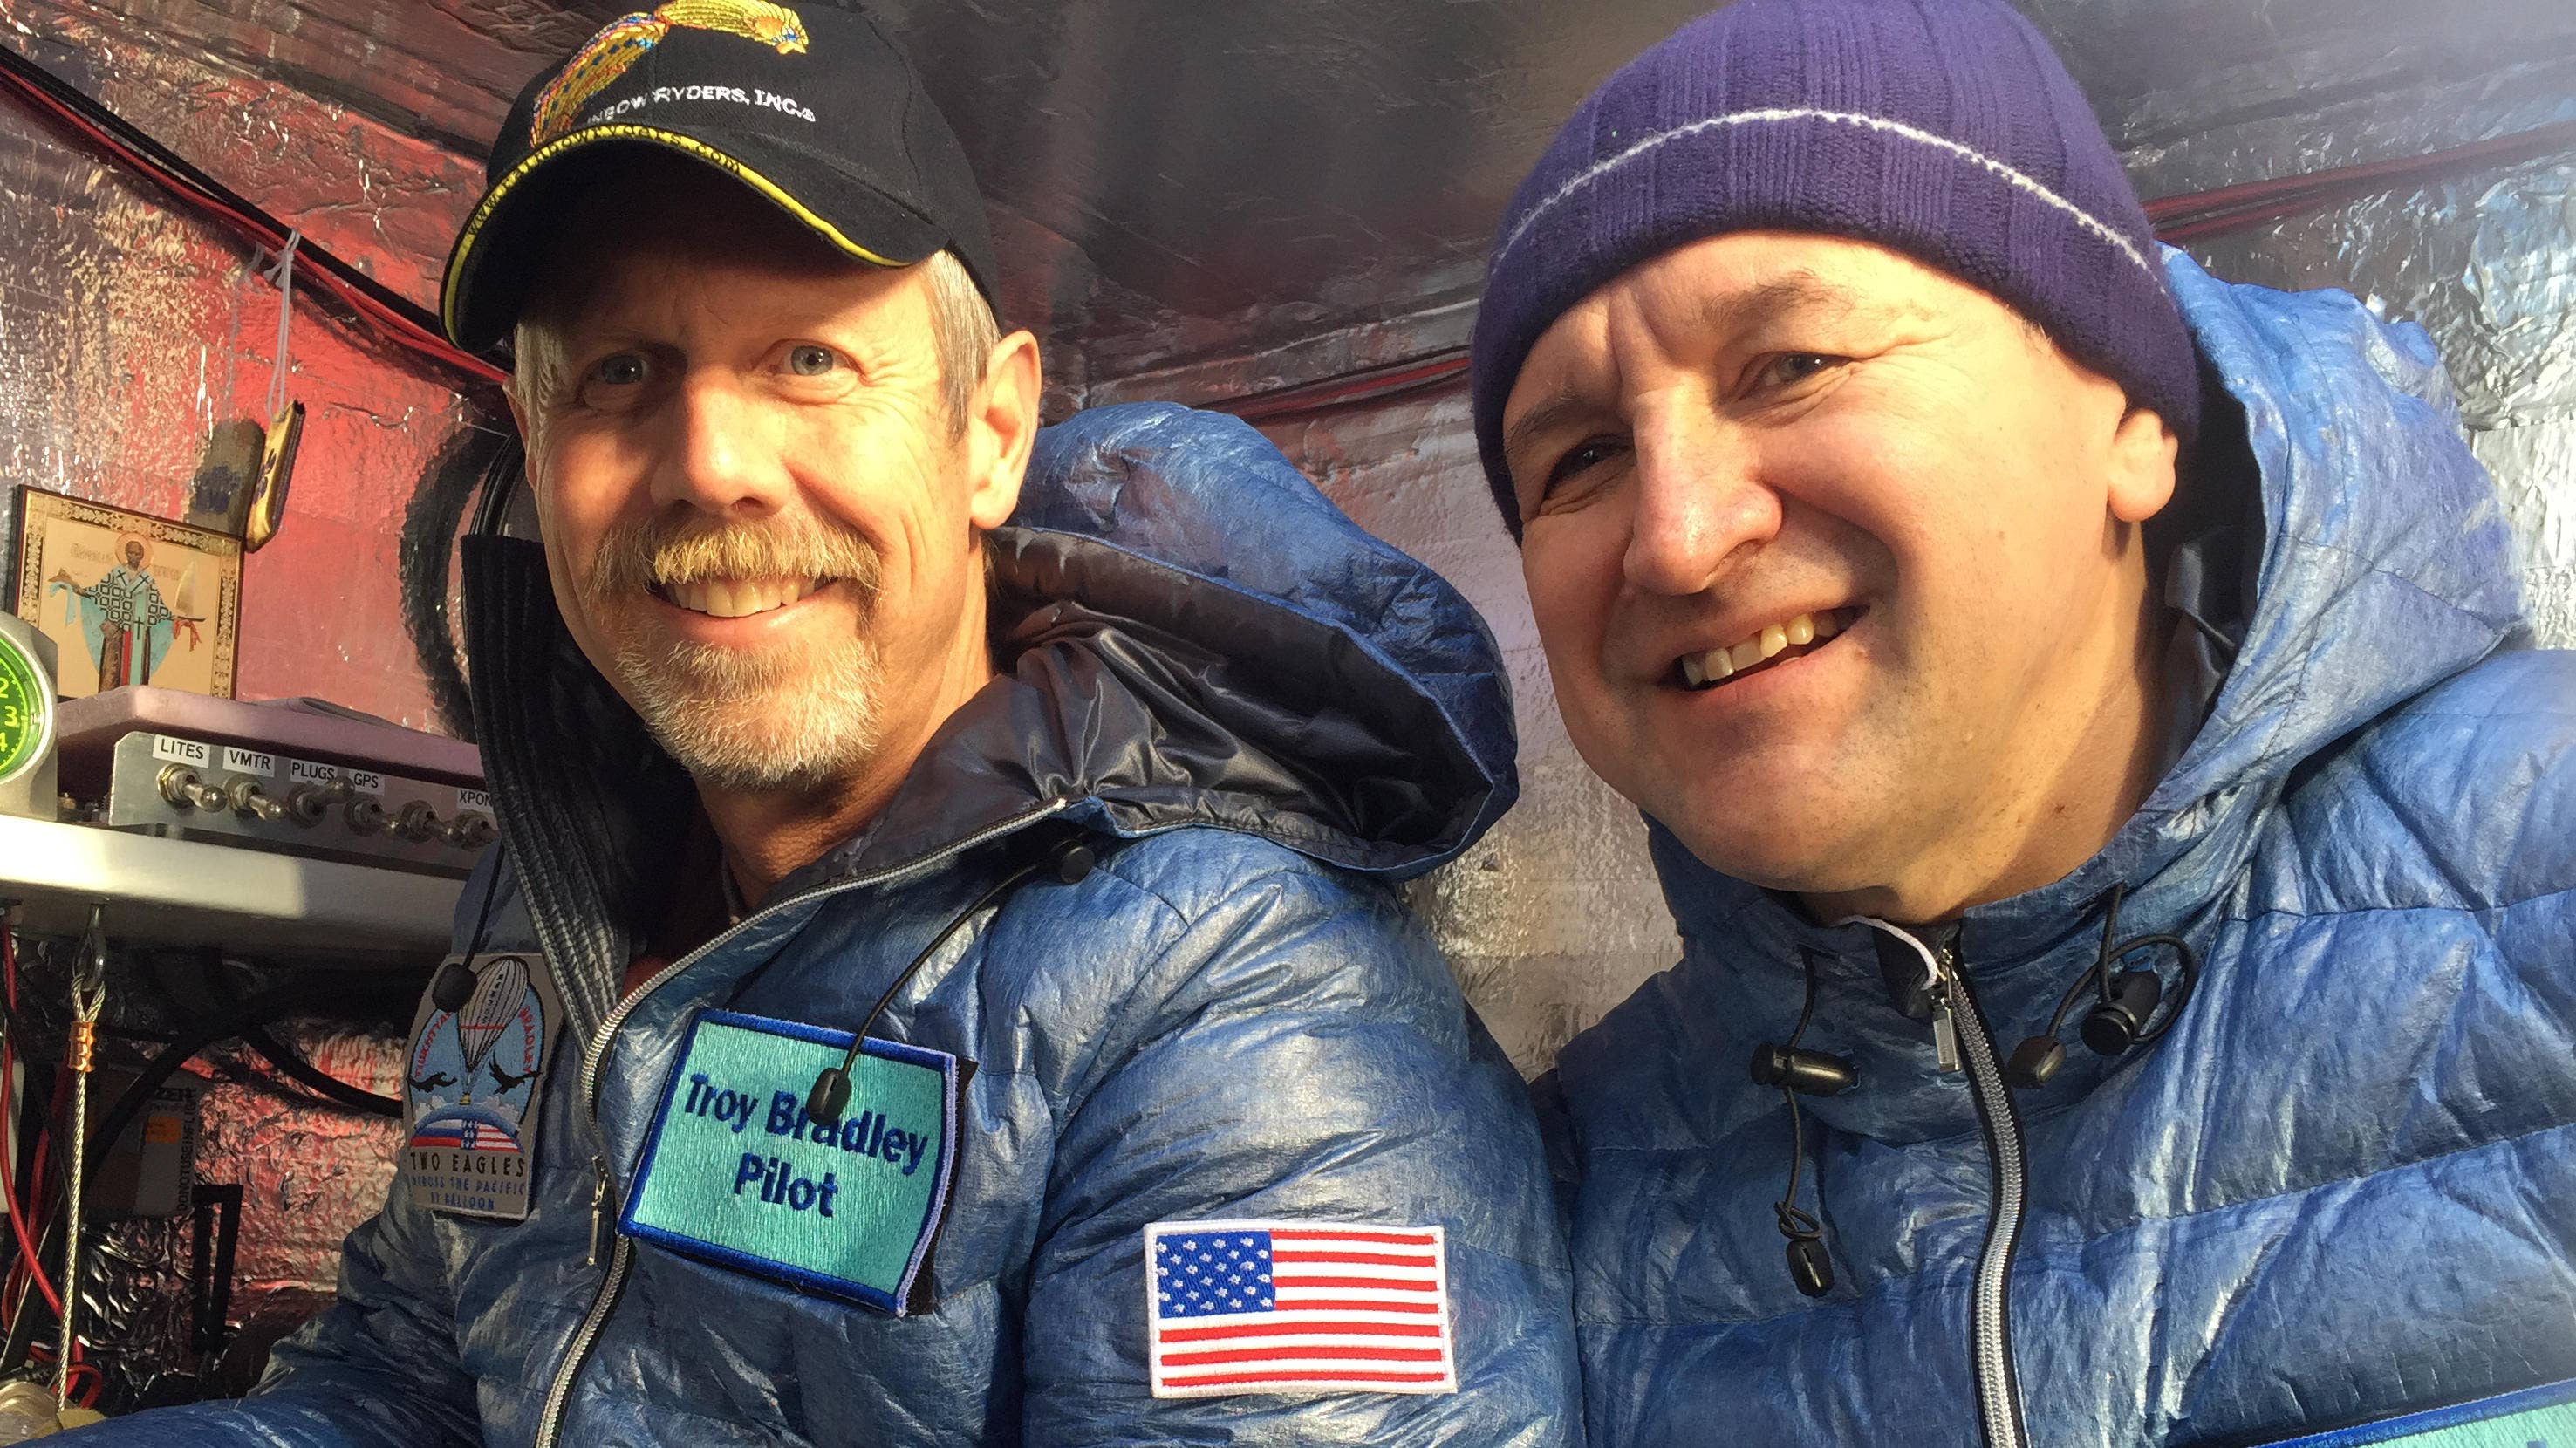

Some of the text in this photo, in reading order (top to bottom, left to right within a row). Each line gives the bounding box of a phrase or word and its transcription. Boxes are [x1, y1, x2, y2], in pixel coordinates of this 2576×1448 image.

[652, 85, 750, 106] RYDERS,
[4, 705, 18, 727] 3
[161, 739, 204, 760] LITES
[229, 750, 271, 770] VMTR
[291, 763, 335, 781] PLUGS
[353, 772, 379, 789] GPS
[683, 1072, 759, 1133] Troy
[410, 1151, 525, 1178] TWO EAGLES
[734, 1152, 838, 1218] Pilot
